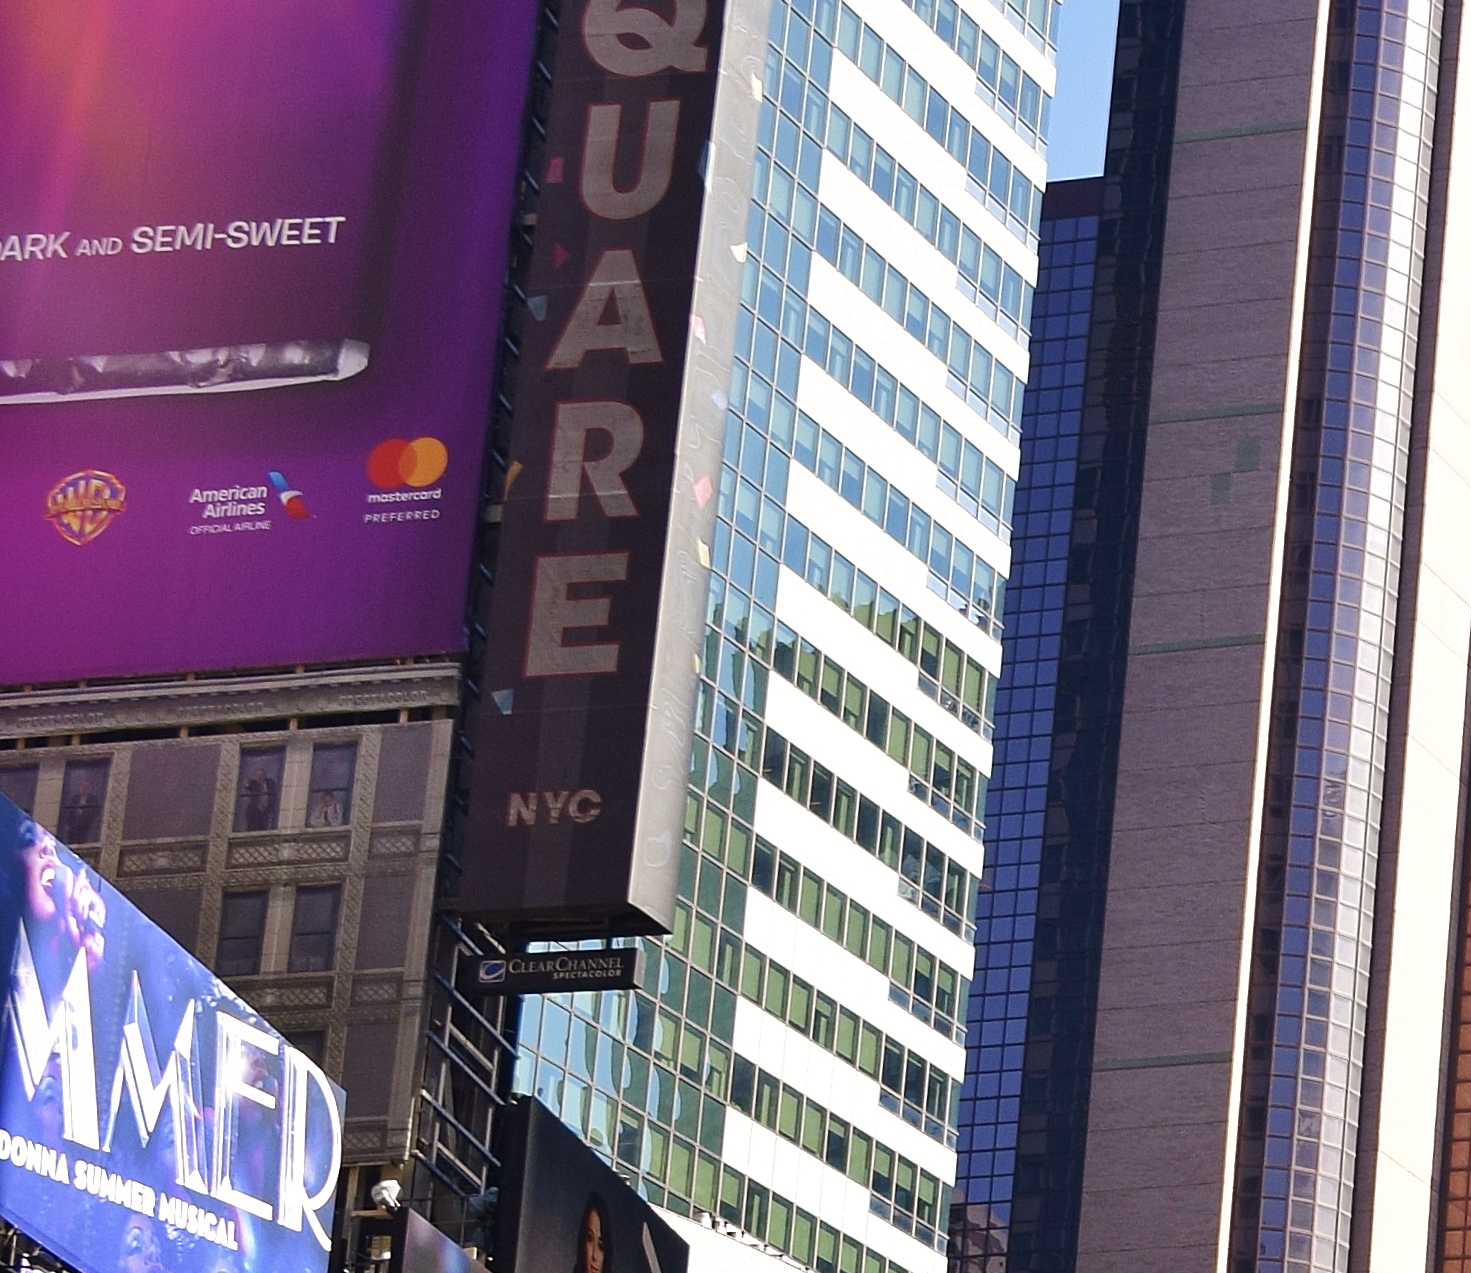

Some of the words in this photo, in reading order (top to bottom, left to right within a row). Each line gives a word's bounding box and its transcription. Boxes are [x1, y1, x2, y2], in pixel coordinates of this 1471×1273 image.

[74, 236, 123, 257] AND
[131, 216, 347, 255] SEMI-SWEET
[189, 484, 269, 505] American
[367, 487, 442, 504] mastercard
[203, 500, 267, 519] Airlines
[363, 508, 441, 525] PREFERRED
[507, 789, 602, 828] NYC
[73, 1160, 156, 1218] SUMMER
[158, 1192, 239, 1251] MUSICAL
